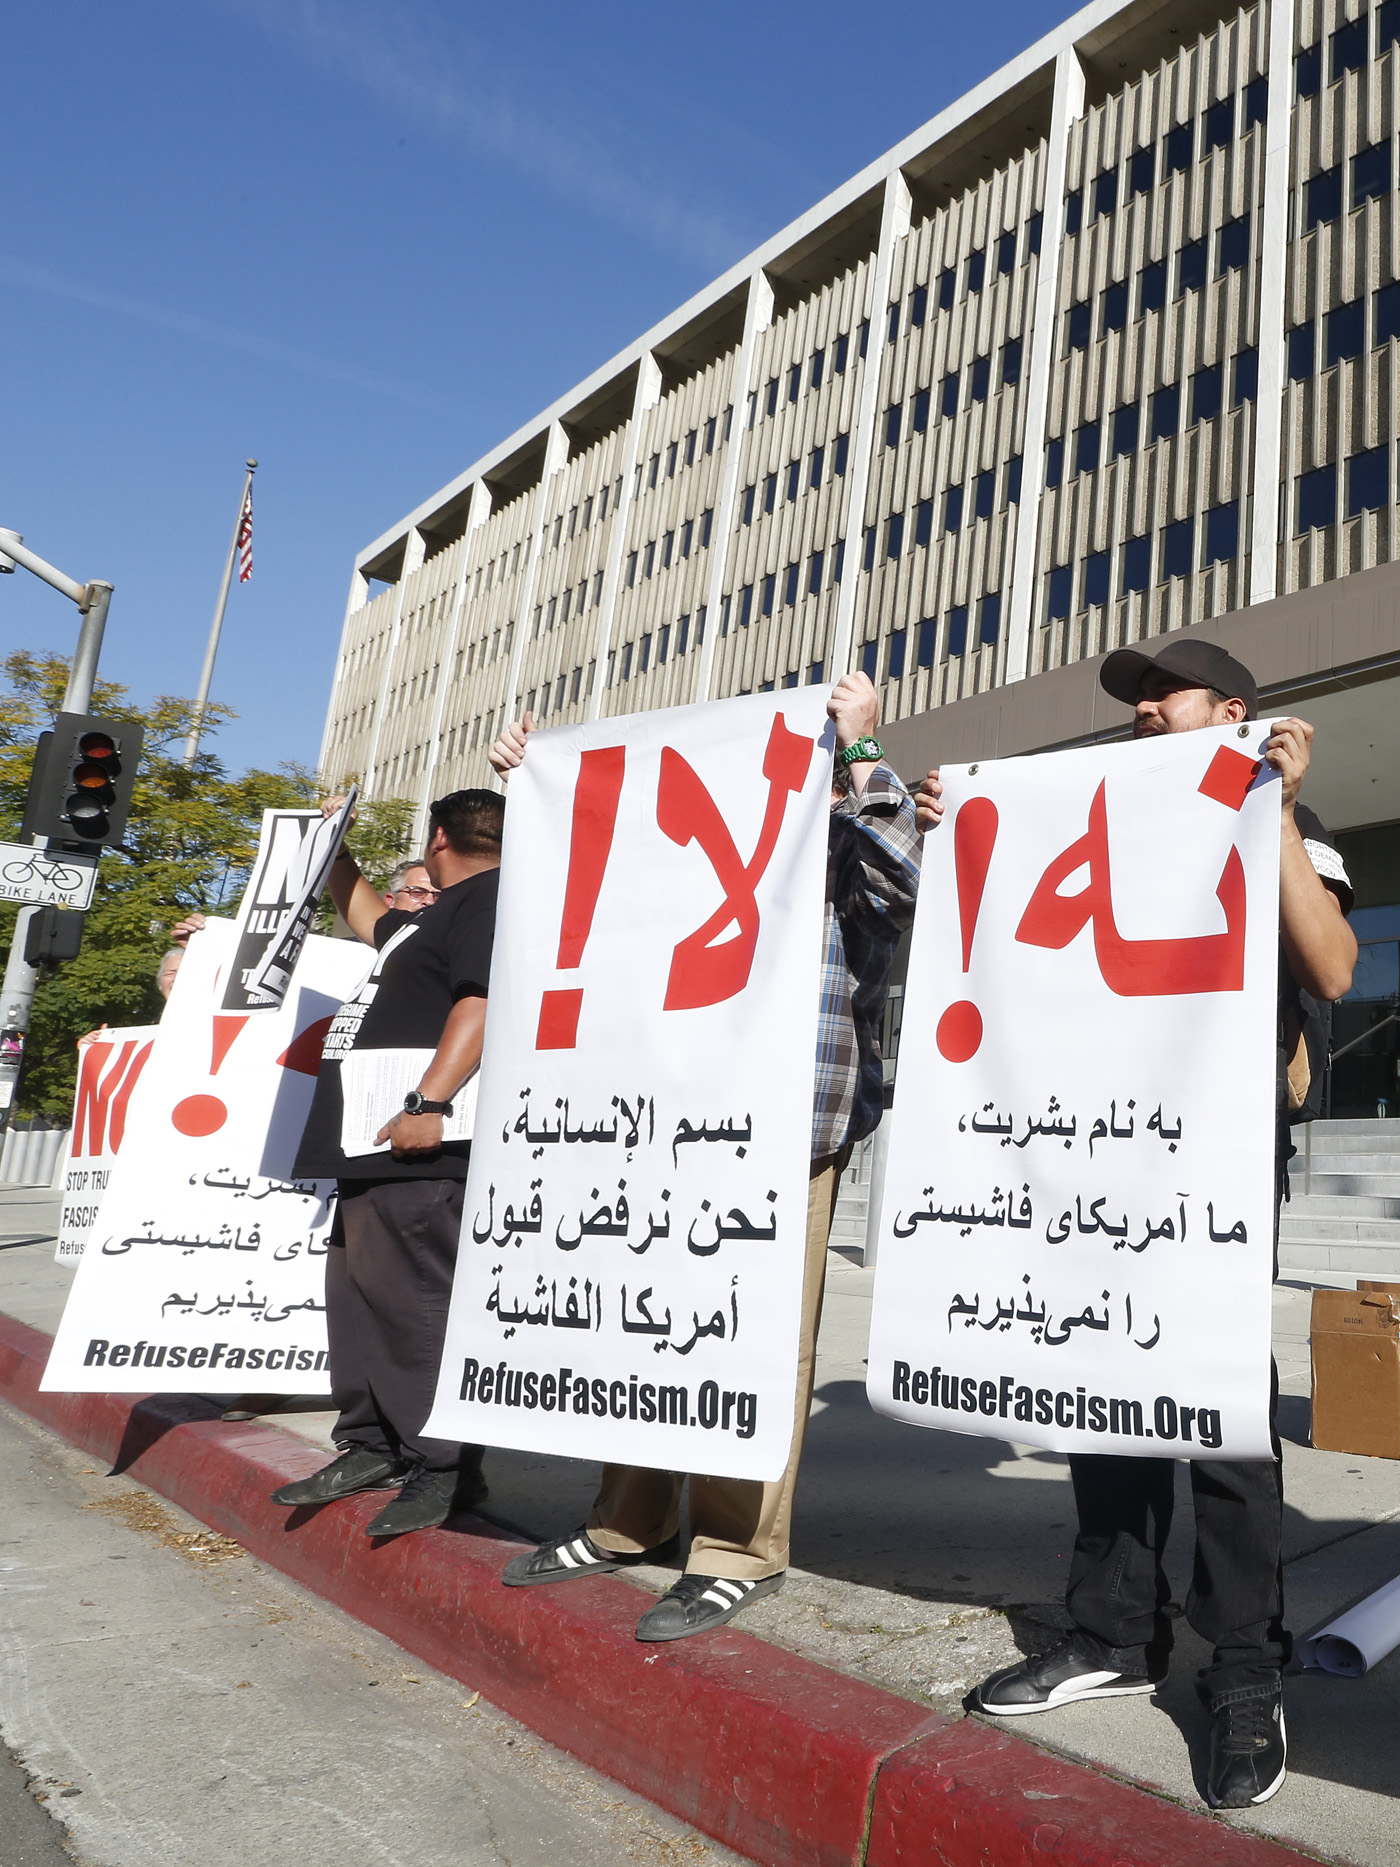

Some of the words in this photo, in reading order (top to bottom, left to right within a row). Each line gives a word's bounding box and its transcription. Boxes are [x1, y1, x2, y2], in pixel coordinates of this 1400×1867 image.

[0, 885, 32, 898] BIKE
[38, 890, 77, 904] LANE
[536, 711, 814, 1051] لا!
[937, 745, 1259, 1063] نه!
[673, 1113, 752, 1169] بسم
[1089, 1099, 1136, 1158] نام
[1147, 1104, 1182, 1154] به
[66, 1170, 88, 1191] STOP
[472, 1178, 543, 1248] قبول
[893, 1183, 1033, 1239] فاشیستی
[62, 1206, 98, 1228] FASCIS
[556, 1179, 671, 1255] نرفض
[687, 1189, 778, 1257] نحن
[1206, 1201, 1248, 1244] ما
[486, 1264, 602, 1340] الفاشية
[621, 1275, 740, 1356] أمريكا
[459, 1357, 758, 1439] RefuseFascism.Org
[893, 1361, 1222, 1448] RefuseFascism.Org
